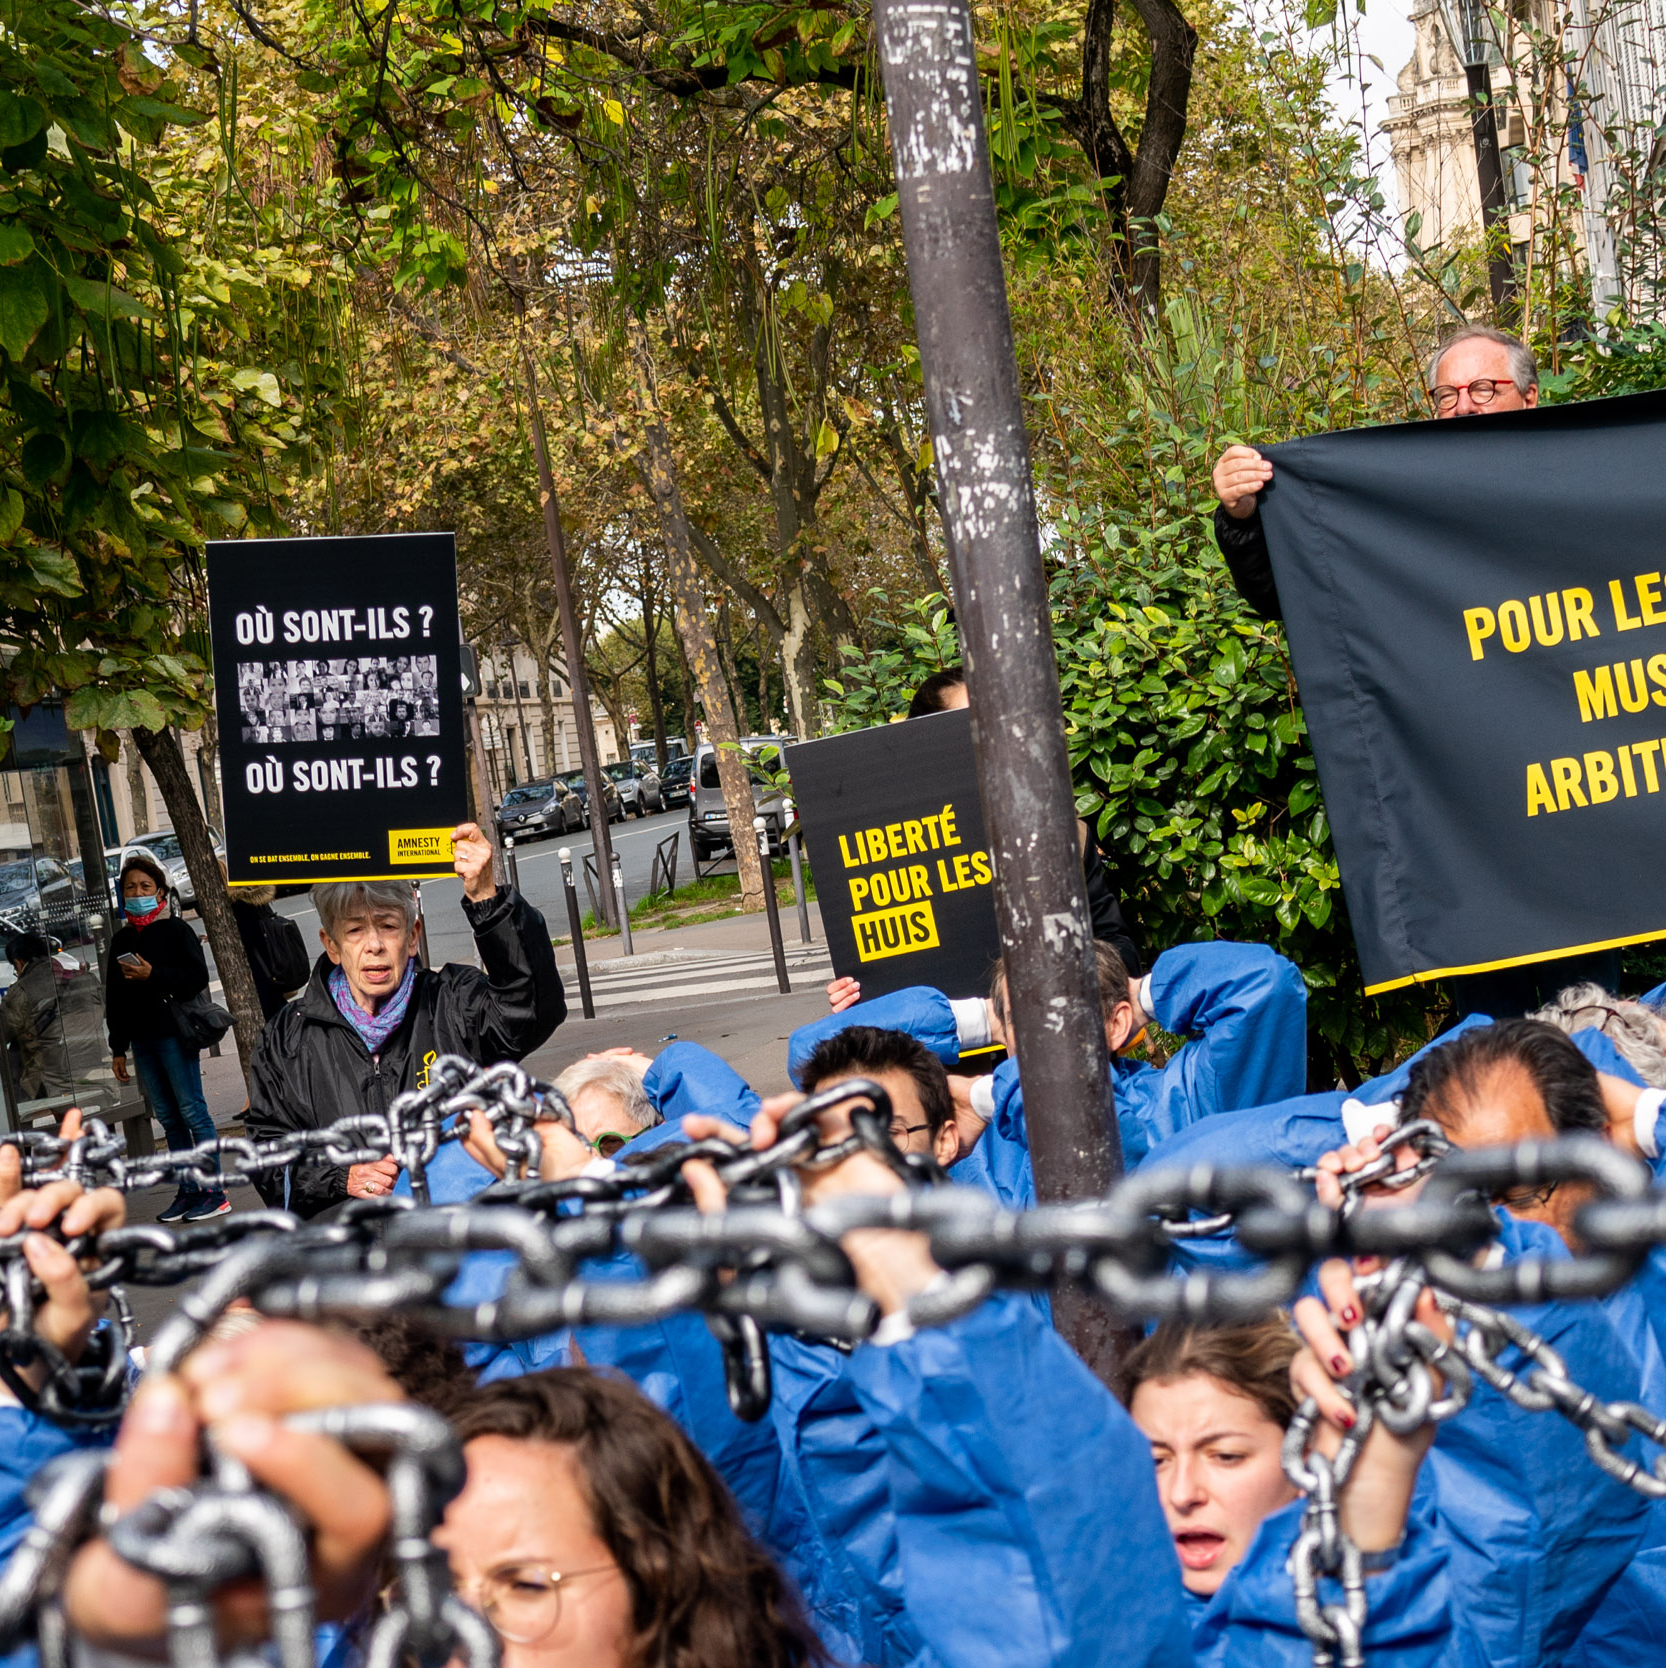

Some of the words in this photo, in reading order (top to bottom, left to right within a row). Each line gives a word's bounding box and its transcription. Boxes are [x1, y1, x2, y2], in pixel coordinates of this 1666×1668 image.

[236, 605, 274, 645] OÙ
[283, 606, 411, 644] SONT-ILS
[418, 605, 434, 637] ?
[1462, 585, 1600, 662] POUR
[245, 755, 283, 794] OÙ
[293, 756, 419, 792] SONT-ILS
[426, 755, 442, 786] ?
[397, 836, 440, 849] AMNESTY
[397, 848, 441, 857] INTERNATIONAL
[838, 804, 962, 868] LIBERTÉ
[848, 864, 933, 911] POUR
[936, 851, 992, 893] LES
[857, 910, 931, 955] HUIS
